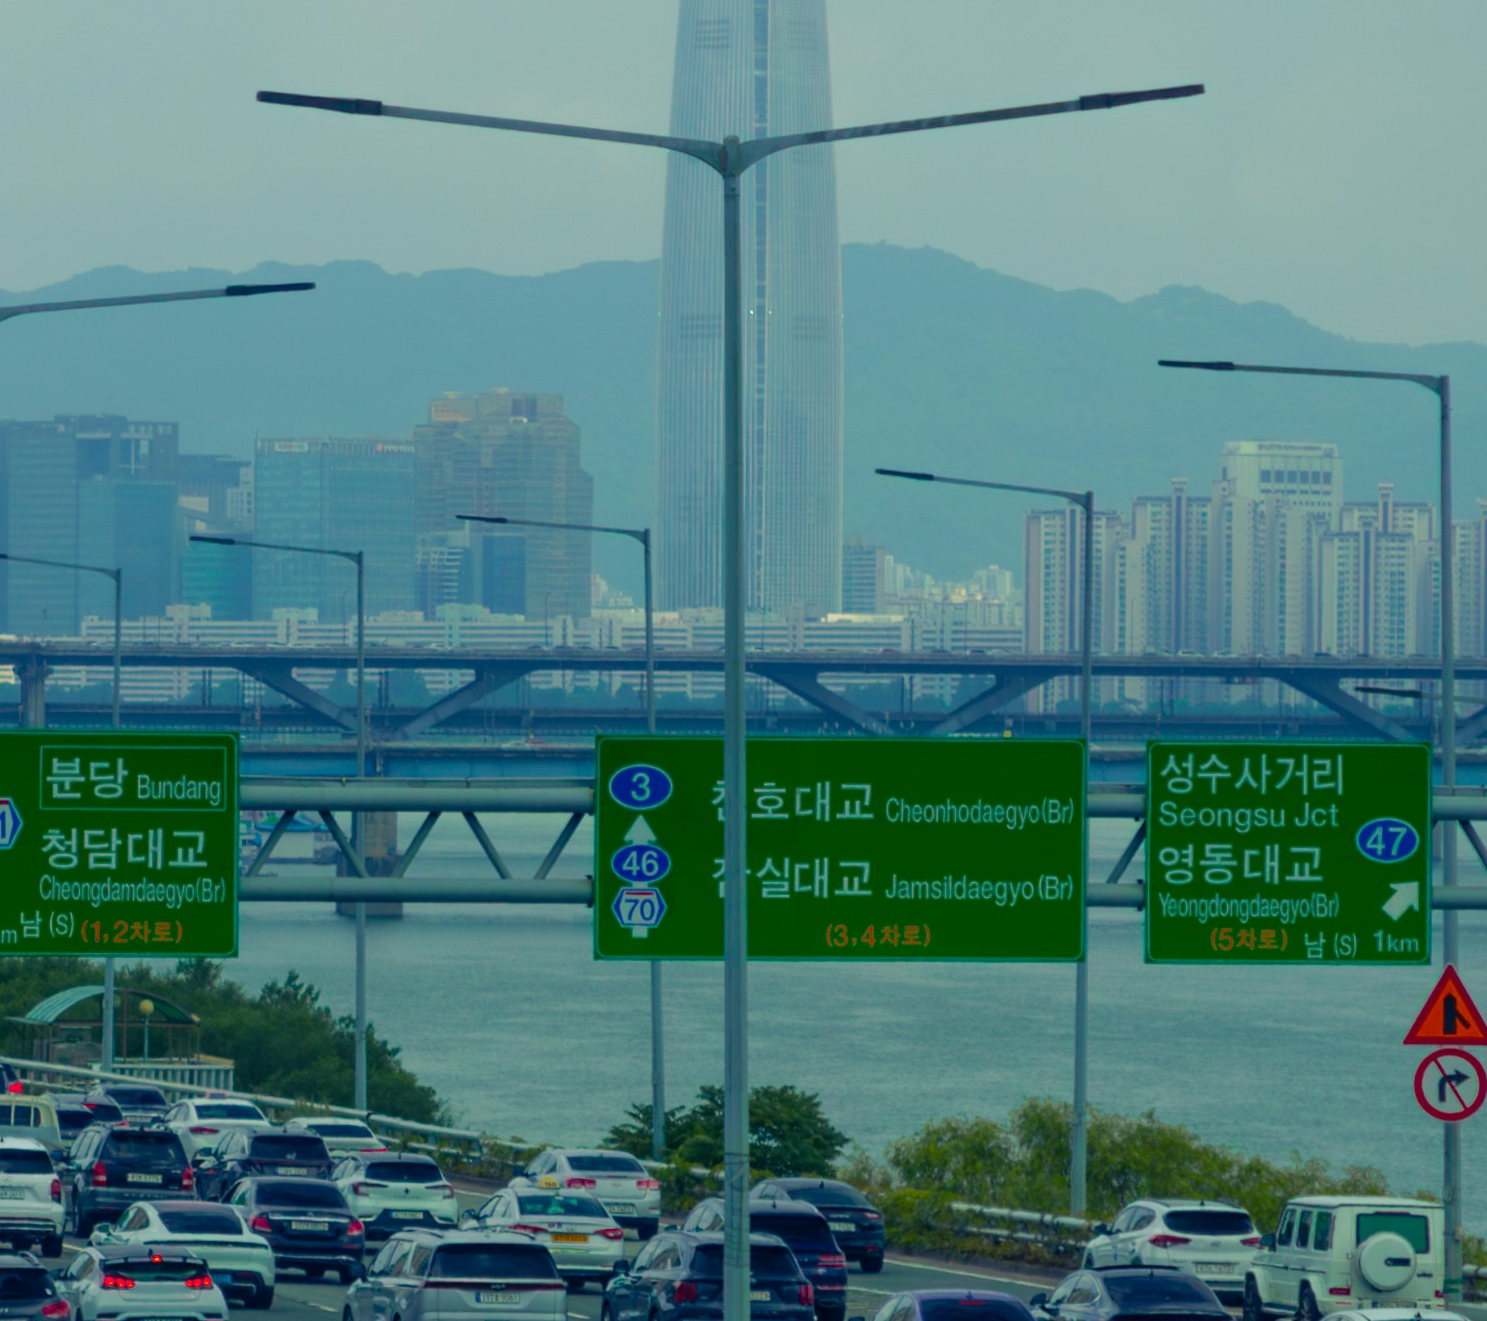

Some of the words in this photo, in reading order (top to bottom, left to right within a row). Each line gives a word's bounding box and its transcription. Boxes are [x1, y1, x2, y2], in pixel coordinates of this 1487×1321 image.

[45, 757, 129, 800] 분당
[137, 774, 221, 806] Bundang
[629, 773, 652, 801] 3
[1158, 753, 1345, 796] 성수사거리
[885, 796, 1074, 831] Cheonhodaegyo(Br)
[1158, 800, 1286, 833] Seongsu
[1294, 802, 1340, 828] Jct
[41, 827, 209, 871] 청담대교
[1364, 827, 1408, 857] 47
[621, 850, 660, 876] 46
[1158, 842, 1324, 886] 영동대교
[39, 874, 226, 910] Cheongdamdaegyo(Br)
[884, 874, 1074, 907] Jamsildaegyo(Br)
[625, 899, 656, 921] 70
[1158, 892, 1340, 924] Yeongdongdaegyo(Br)
[20, 910, 43, 939] 남
[49, 911, 75, 938] (S)
[81, 920, 184, 945] (1,2차로)
[825, 923, 931, 949] (3,4차로)
[1210, 928, 1289, 952] (5차로)
[1303, 931, 1326, 959] 남
[1333, 932, 1358, 959] (S)
[1373, 929, 1420, 953] 1km
